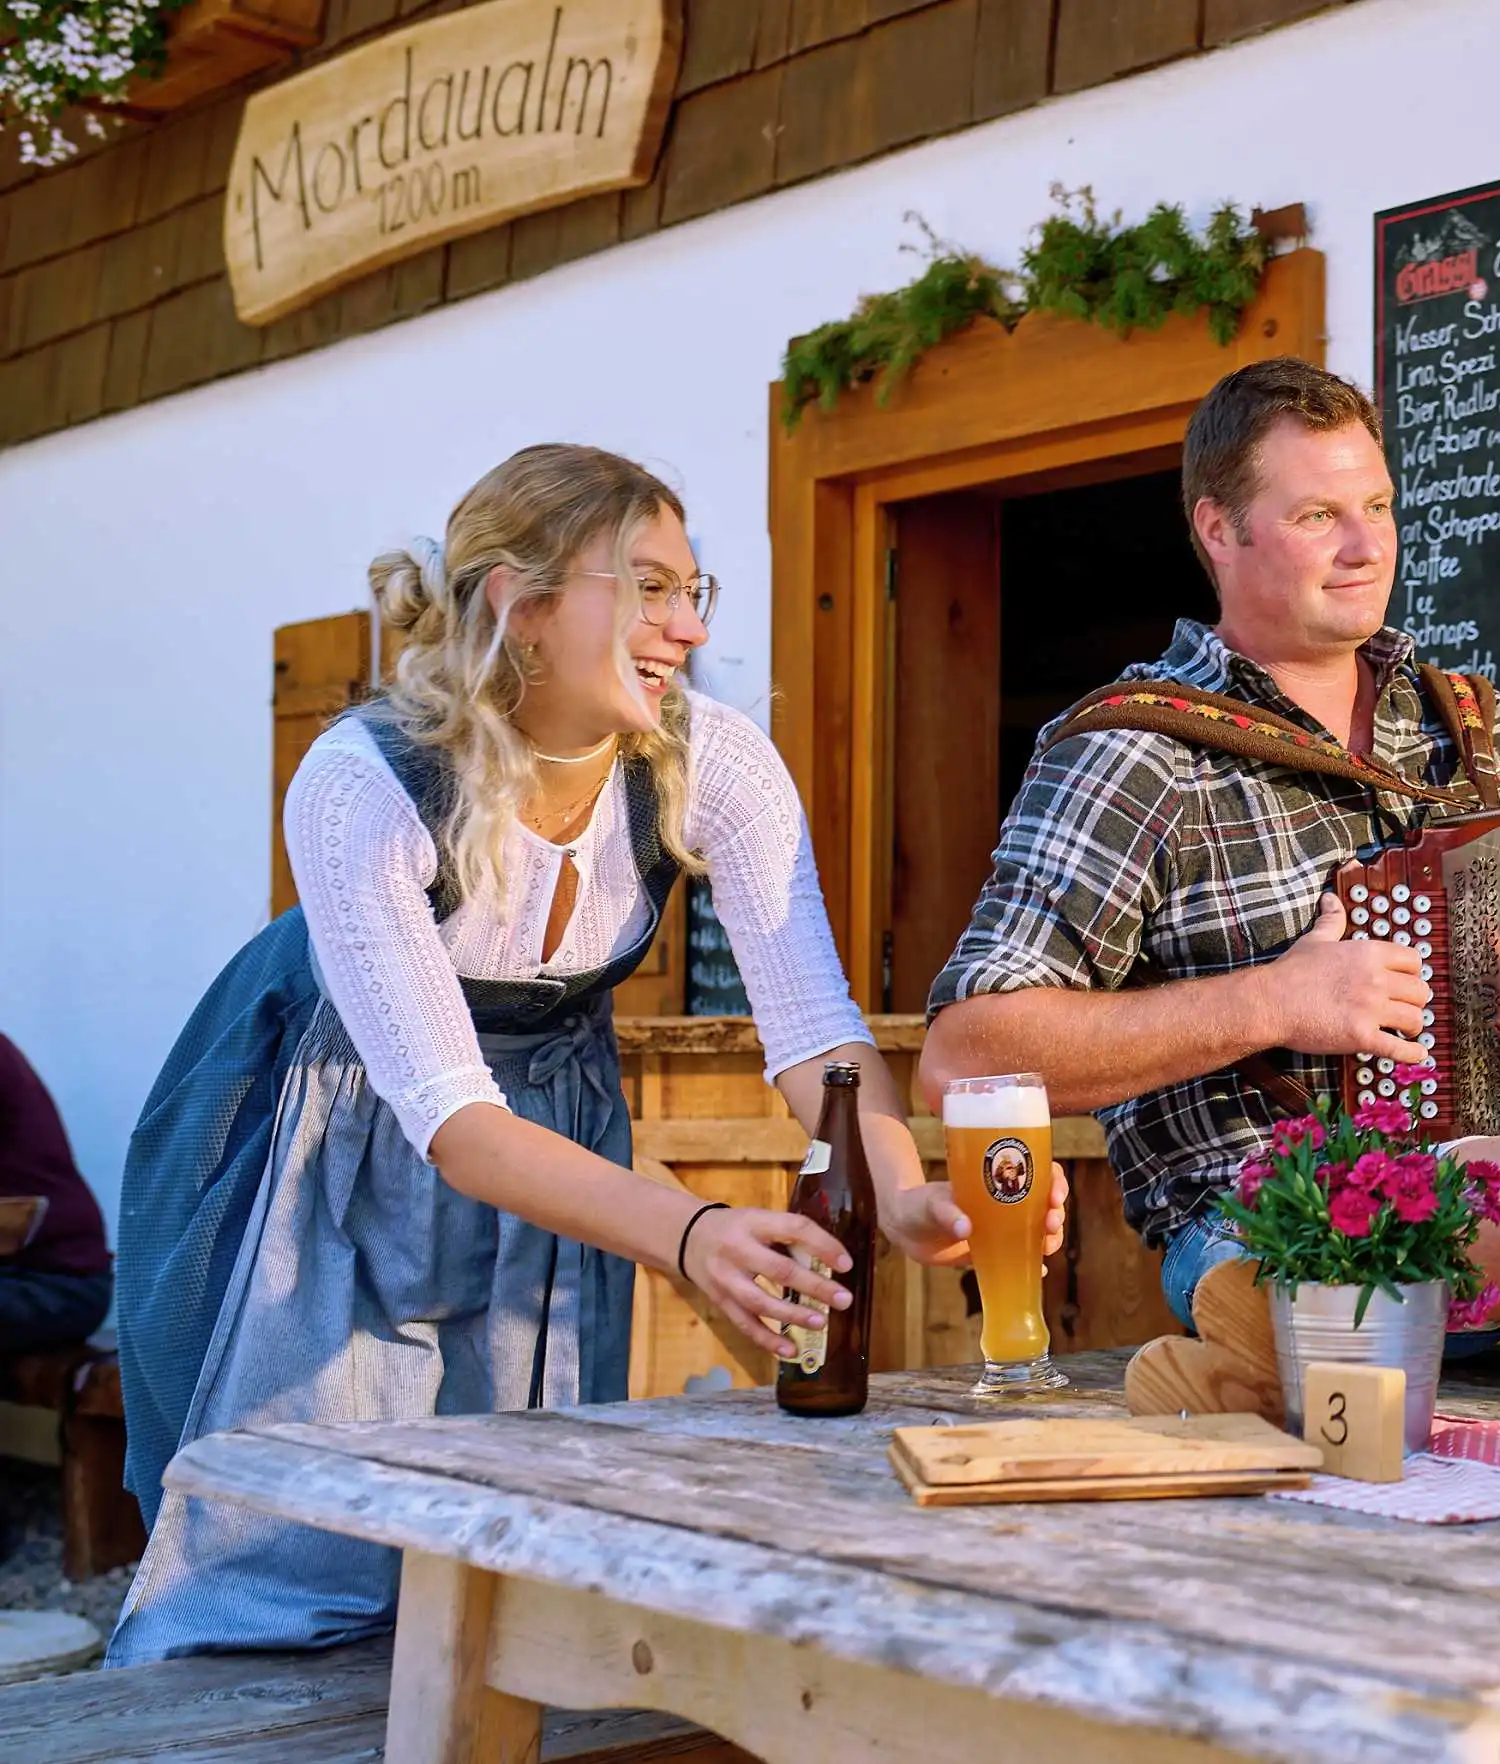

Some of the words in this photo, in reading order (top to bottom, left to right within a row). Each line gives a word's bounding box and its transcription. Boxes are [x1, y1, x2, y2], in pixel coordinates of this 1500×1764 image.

[250, 5, 614, 271] Mordaualm
[373, 159, 446, 236] 1200
[452, 163, 482, 212] m
[1438, 345, 1497, 385] Spezi
[1401, 543, 1462, 586] Kaffee
[1403, 579, 1437, 615] Tee
[1402, 615, 1481, 651] Schnaps
[1320, 1391, 1349, 1447] 3
